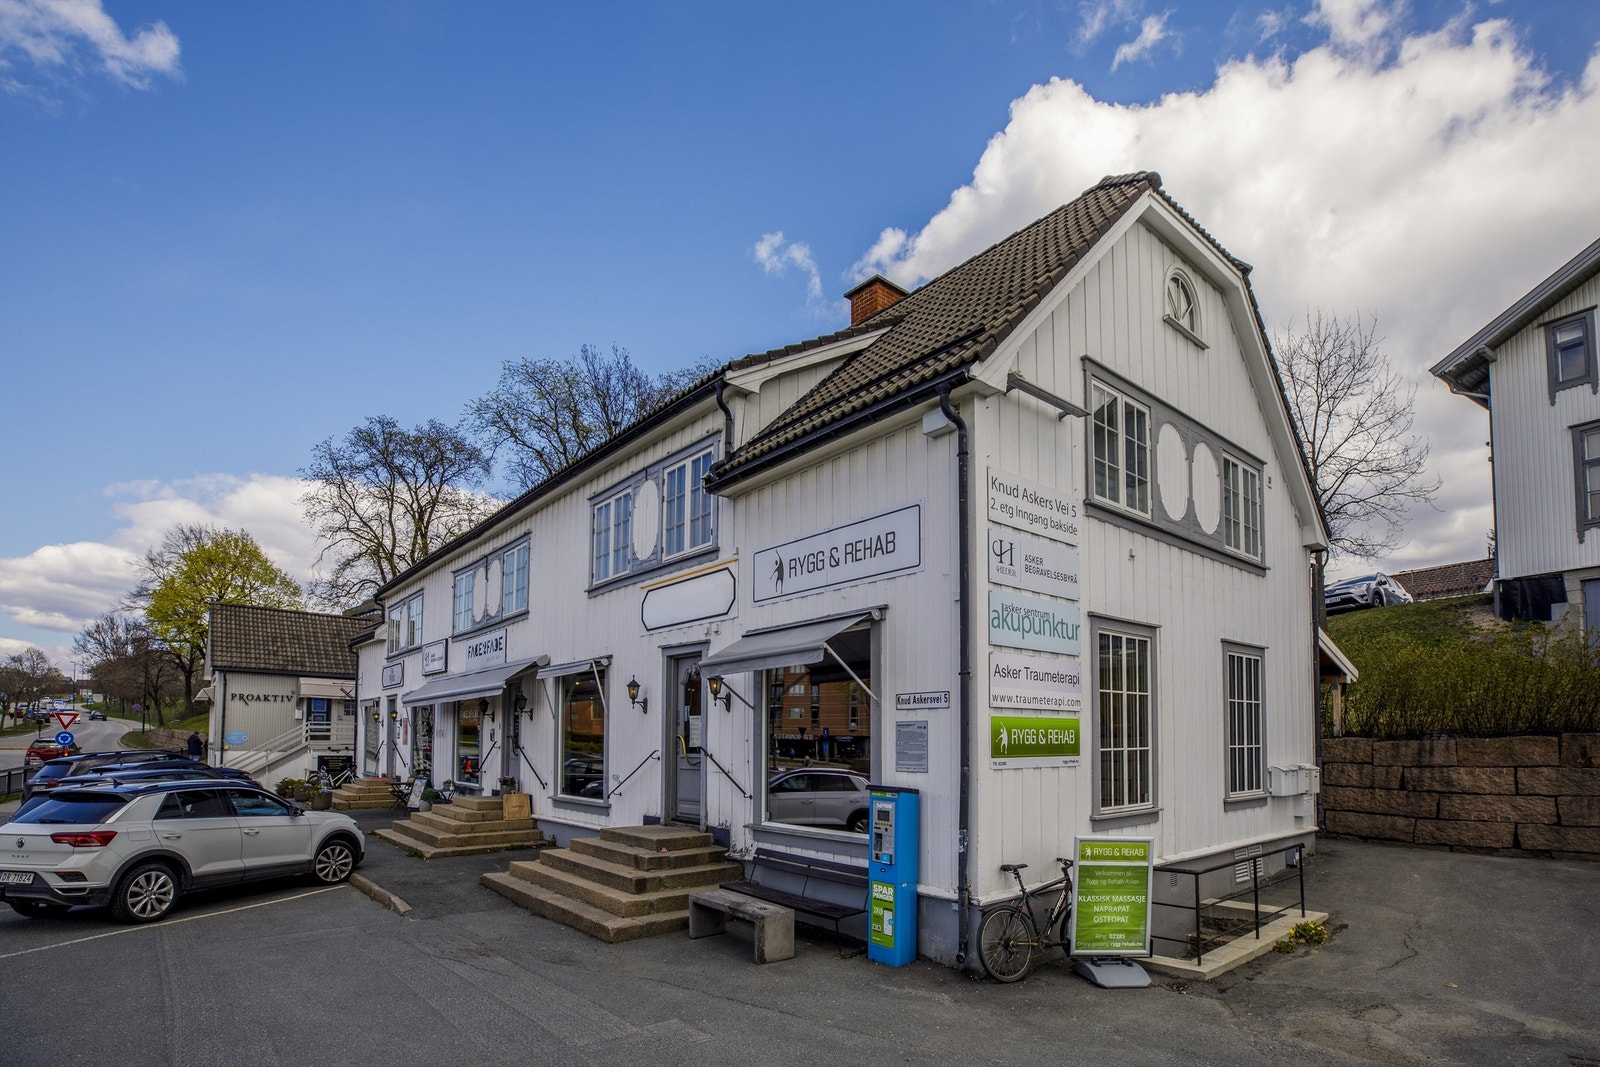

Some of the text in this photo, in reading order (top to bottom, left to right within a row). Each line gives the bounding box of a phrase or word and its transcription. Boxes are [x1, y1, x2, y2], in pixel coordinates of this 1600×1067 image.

[991, 476, 1077, 517] Knud Askers Vei 5
[991, 498, 1077, 536] 2. etg Inngang bakside
[788, 531, 896, 578] RYGG & REHAB
[1024, 554, 1044, 566] ASKER
[1024, 564, 1078, 584] BEGRAVELSESBYRÅ
[1004, 604, 1050, 619] asker sentrum
[991, 603, 1080, 641] akupunktur
[994, 664, 1080, 687] Asker Traumeterapi
[231, 693, 293, 705] PROAKTIV
[898, 694, 948, 705] Knud Askersvei 5
[992, 694, 1081, 707] www.traumeterapi.com
[1011, 729, 1075, 744] RYGG & REHAB
[1094, 848, 1112, 856] RYGG
[872, 884, 894, 896] SPAR
